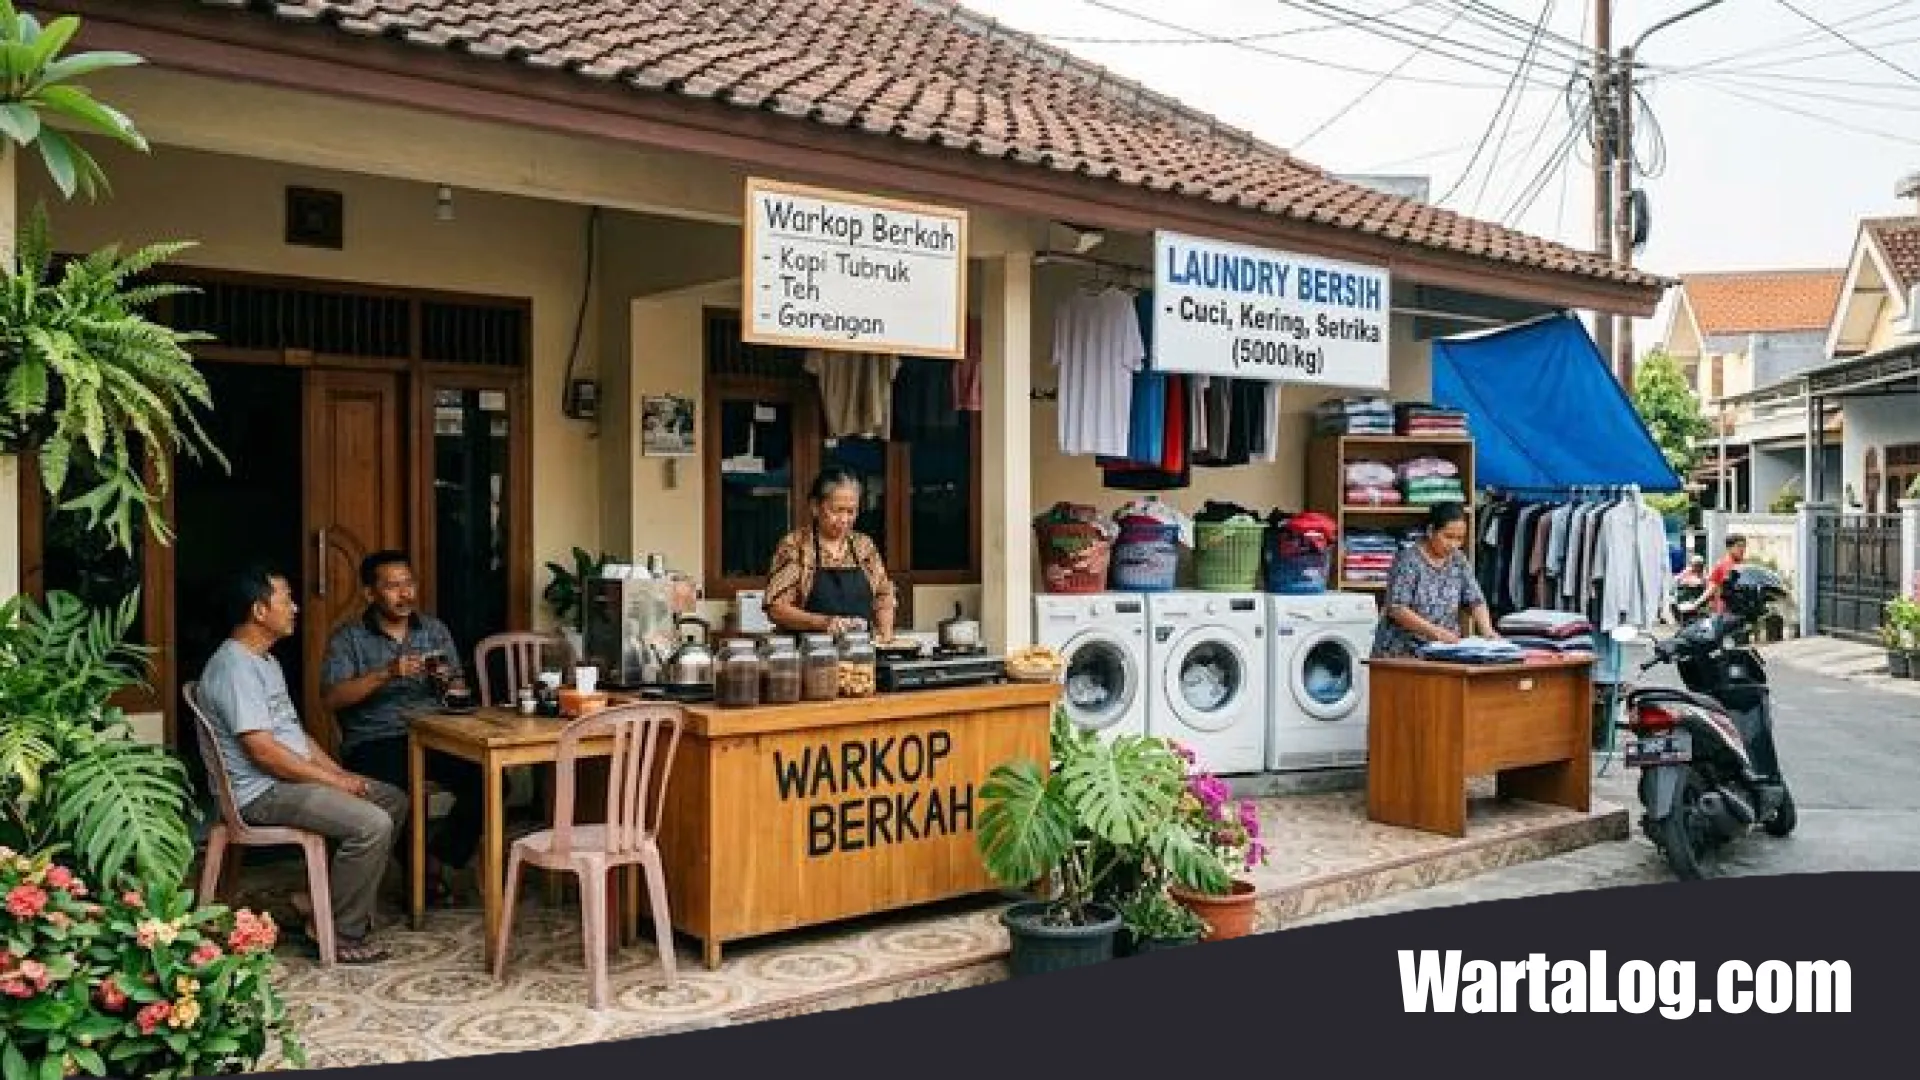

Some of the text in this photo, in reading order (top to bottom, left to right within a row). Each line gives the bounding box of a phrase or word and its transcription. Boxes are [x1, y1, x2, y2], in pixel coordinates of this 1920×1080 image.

[764, 199, 955, 251] Warkop Berkah
[778, 273, 820, 302] Teh
[779, 247, 828, 281] Kopi
[835, 252, 911, 283] Tubruk
[1168, 246, 1381, 311] LAUNDRY BERSIH
[778, 302, 885, 340] Gorengan
[1180, 295, 1233, 331] Cuci,
[1240, 301, 1310, 339] Kering,
[1316, 312, 1381, 342] Setrika
[1232, 338, 1324, 374] (5000/kg)
[773, 729, 951, 801] WARKOP
[808, 782, 974, 858] BERKAH
